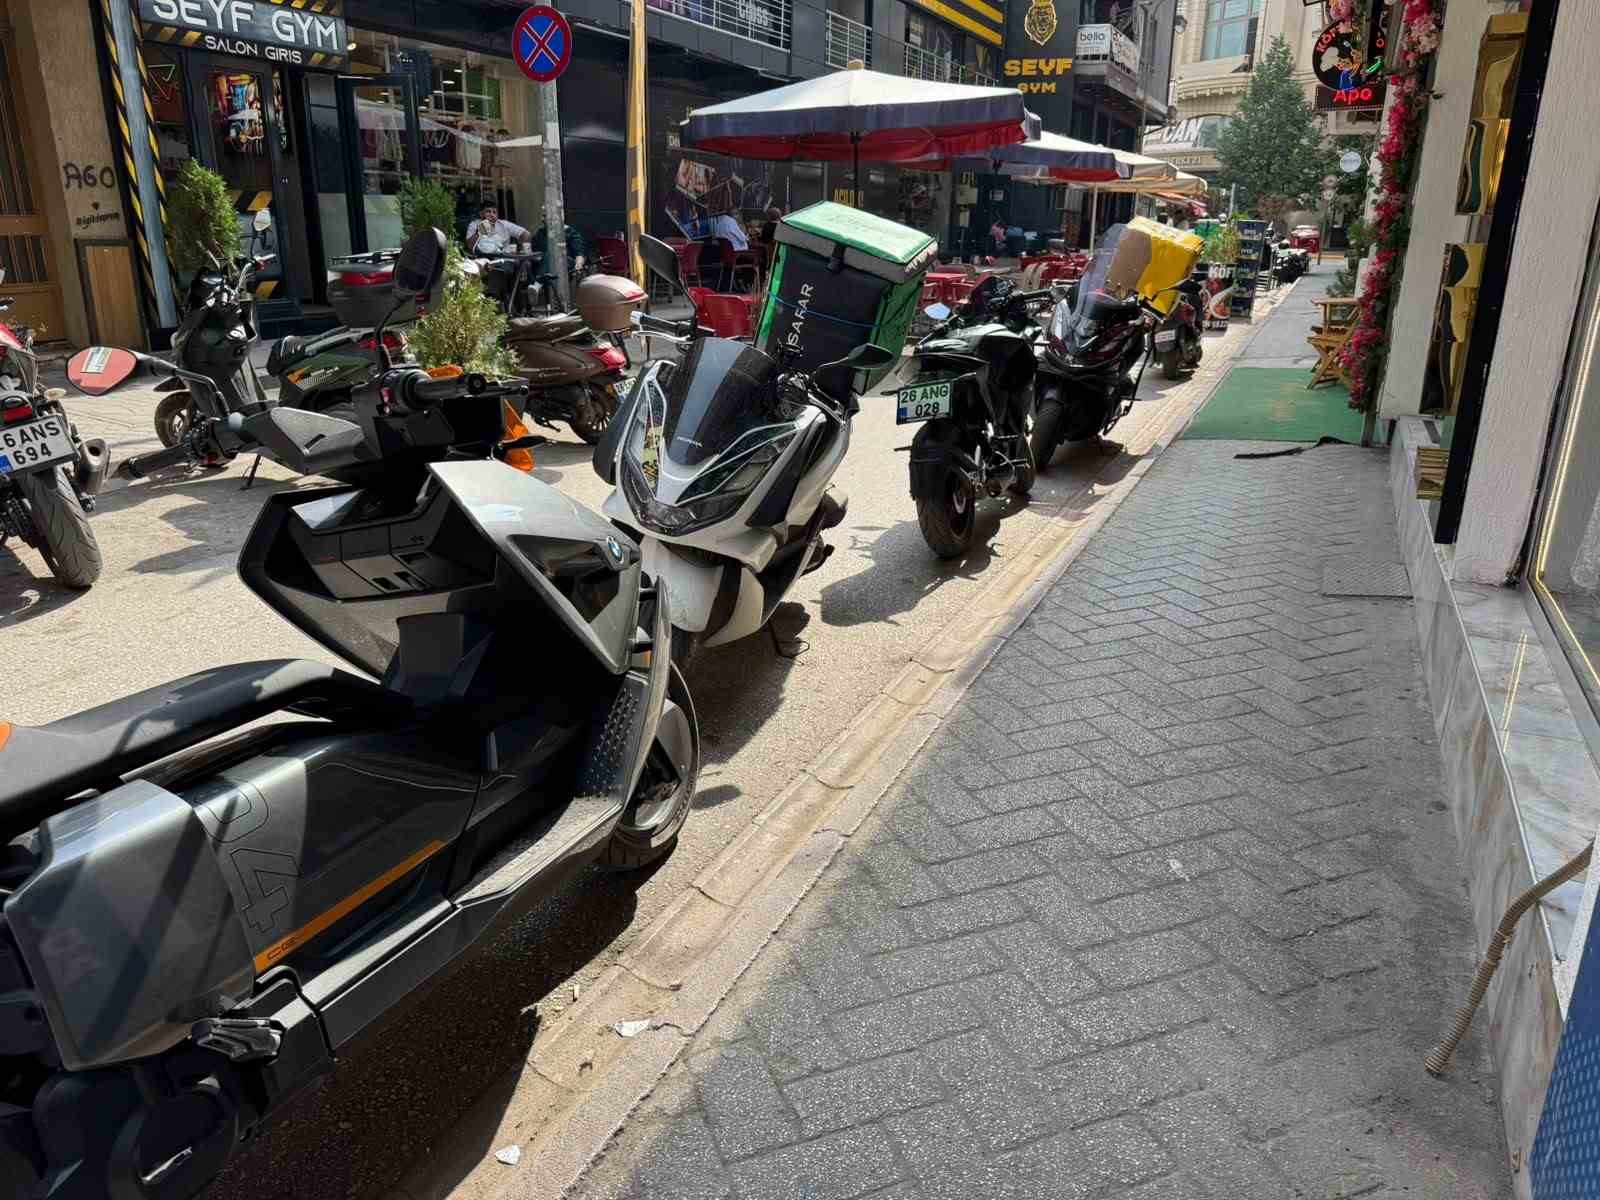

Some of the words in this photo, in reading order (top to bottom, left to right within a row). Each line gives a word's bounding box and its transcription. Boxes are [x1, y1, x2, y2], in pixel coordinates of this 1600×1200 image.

[152, 0, 254, 33] SEYF
[271, 10, 339, 50] GYM
[204, 35, 258, 56] SALON
[264, 46, 303, 64] GIRIS
[1003, 58, 1073, 76] SEYF
[1017, 82, 1057, 94] GYM
[900, 390, 917, 404] 26
[920, 385, 949, 401] ANG
[915, 401, 940, 417] 028
[0, 433, 16, 451] 6
[19, 421, 60, 444] ANS
[13, 442, 52, 465] 694
